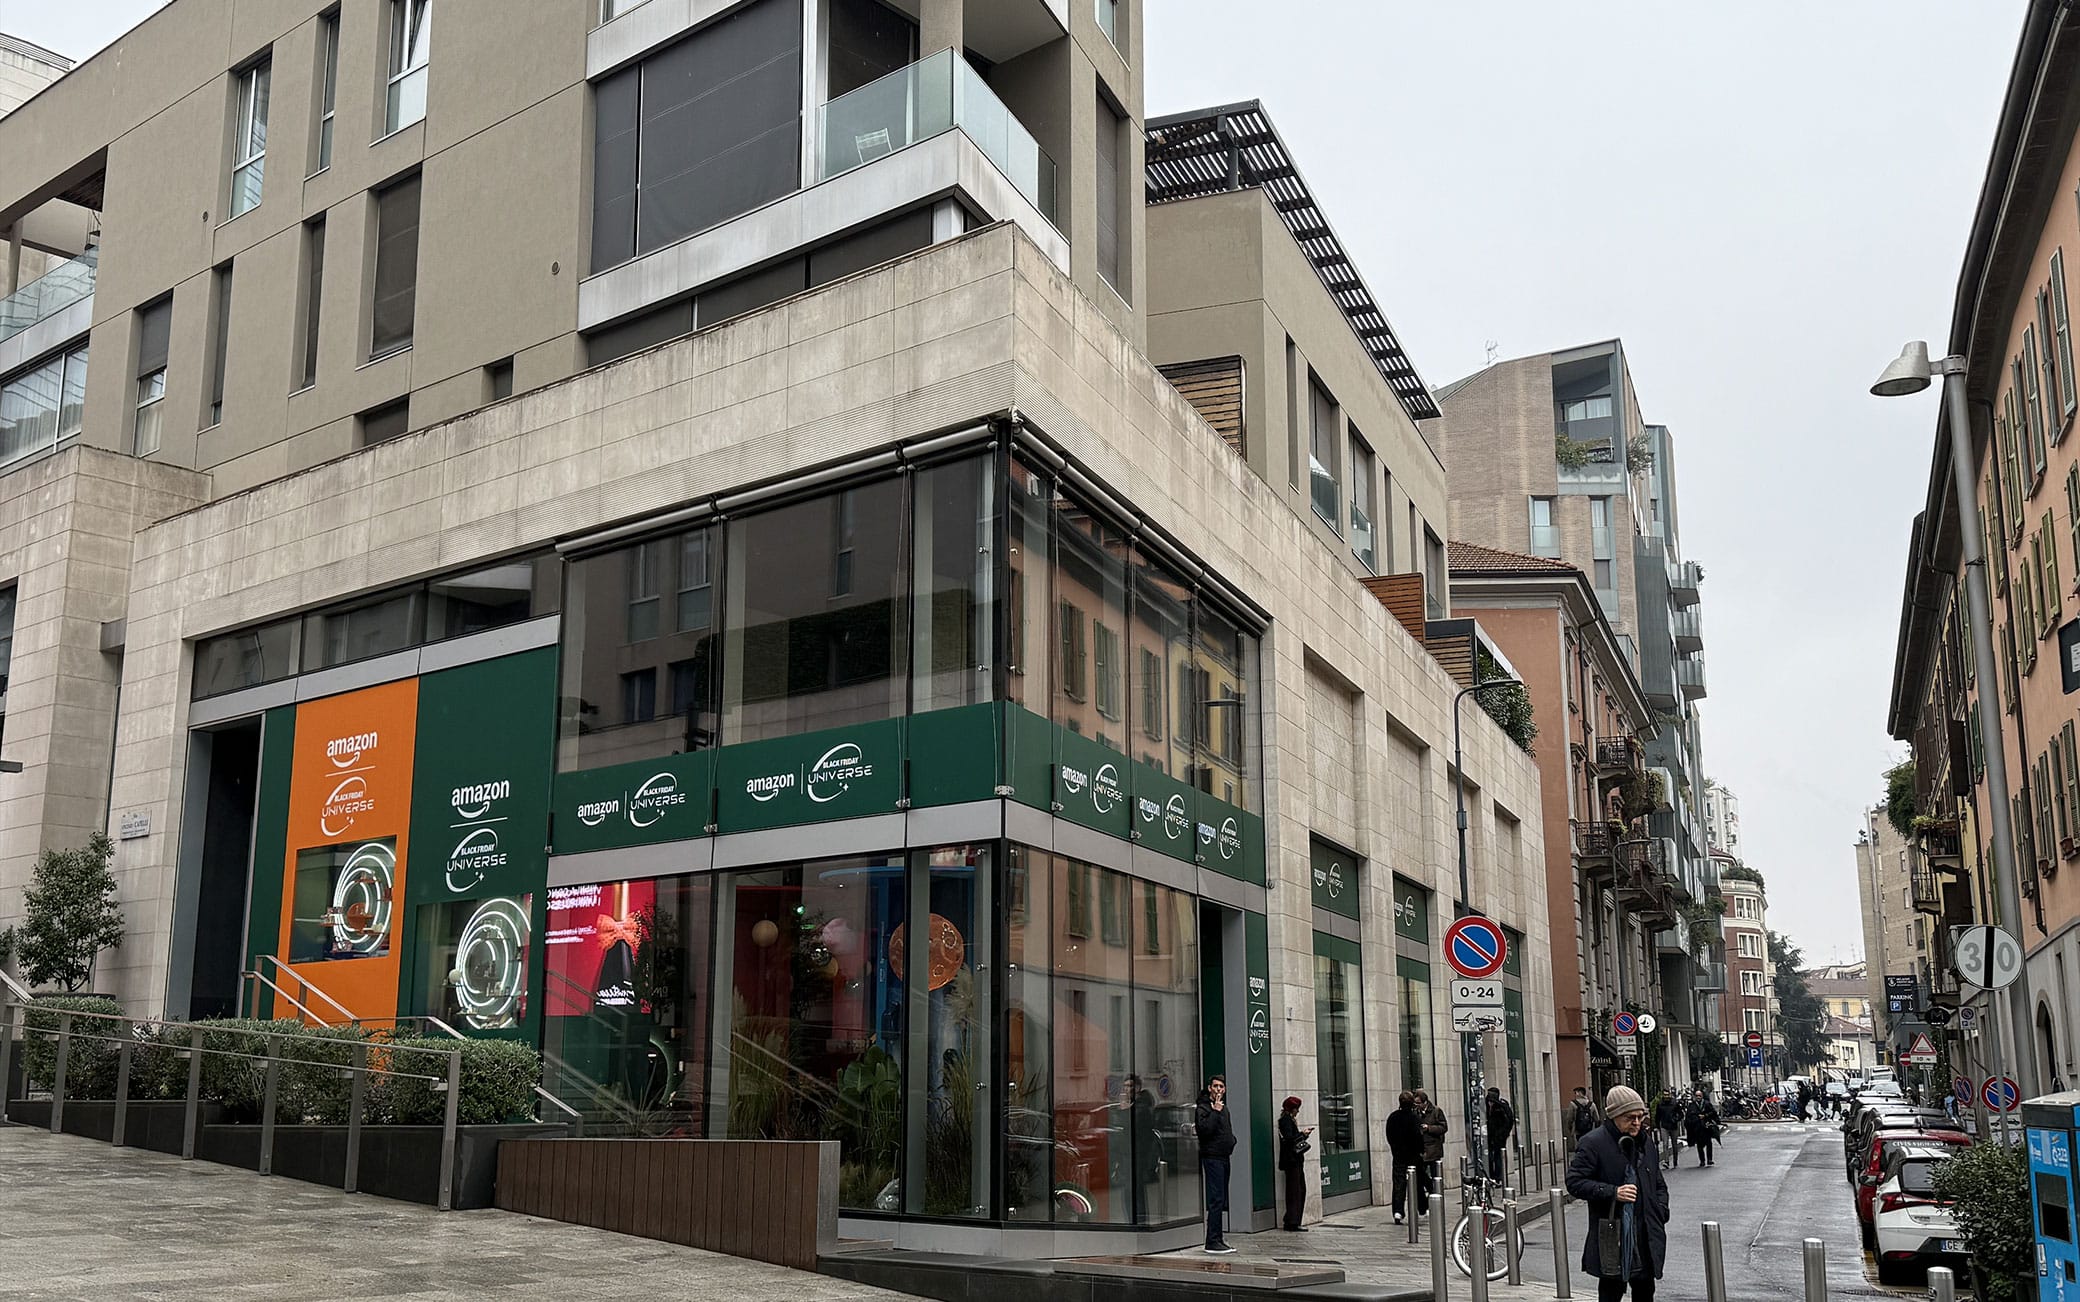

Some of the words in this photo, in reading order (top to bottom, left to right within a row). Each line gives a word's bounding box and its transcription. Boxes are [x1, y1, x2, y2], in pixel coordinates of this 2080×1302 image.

[326, 731, 378, 757] amazon
[823, 760, 839, 769] BLACK
[840, 757, 859, 766] FRIDAY
[746, 773, 795, 793] amazon
[808, 765, 873, 784] UNIVERSE
[1062, 765, 1088, 787] amazon
[451, 780, 510, 807] amazon
[1094, 781, 1123, 802] UNIVERSE
[322, 799, 375, 817] UNIVERSE
[577, 799, 619, 818] amazon
[630, 793, 686, 810] UNIVERSE
[1139, 797, 1160, 817] amazon
[461, 846, 477, 856] BLACK
[477, 844, 496, 854] FRIDAY
[446, 853, 508, 872] UNIVERSE
[1964, 942, 2016, 973] 30
[1460, 986, 1495, 998] 0-24
[1750, 1048, 1759, 1058] P
